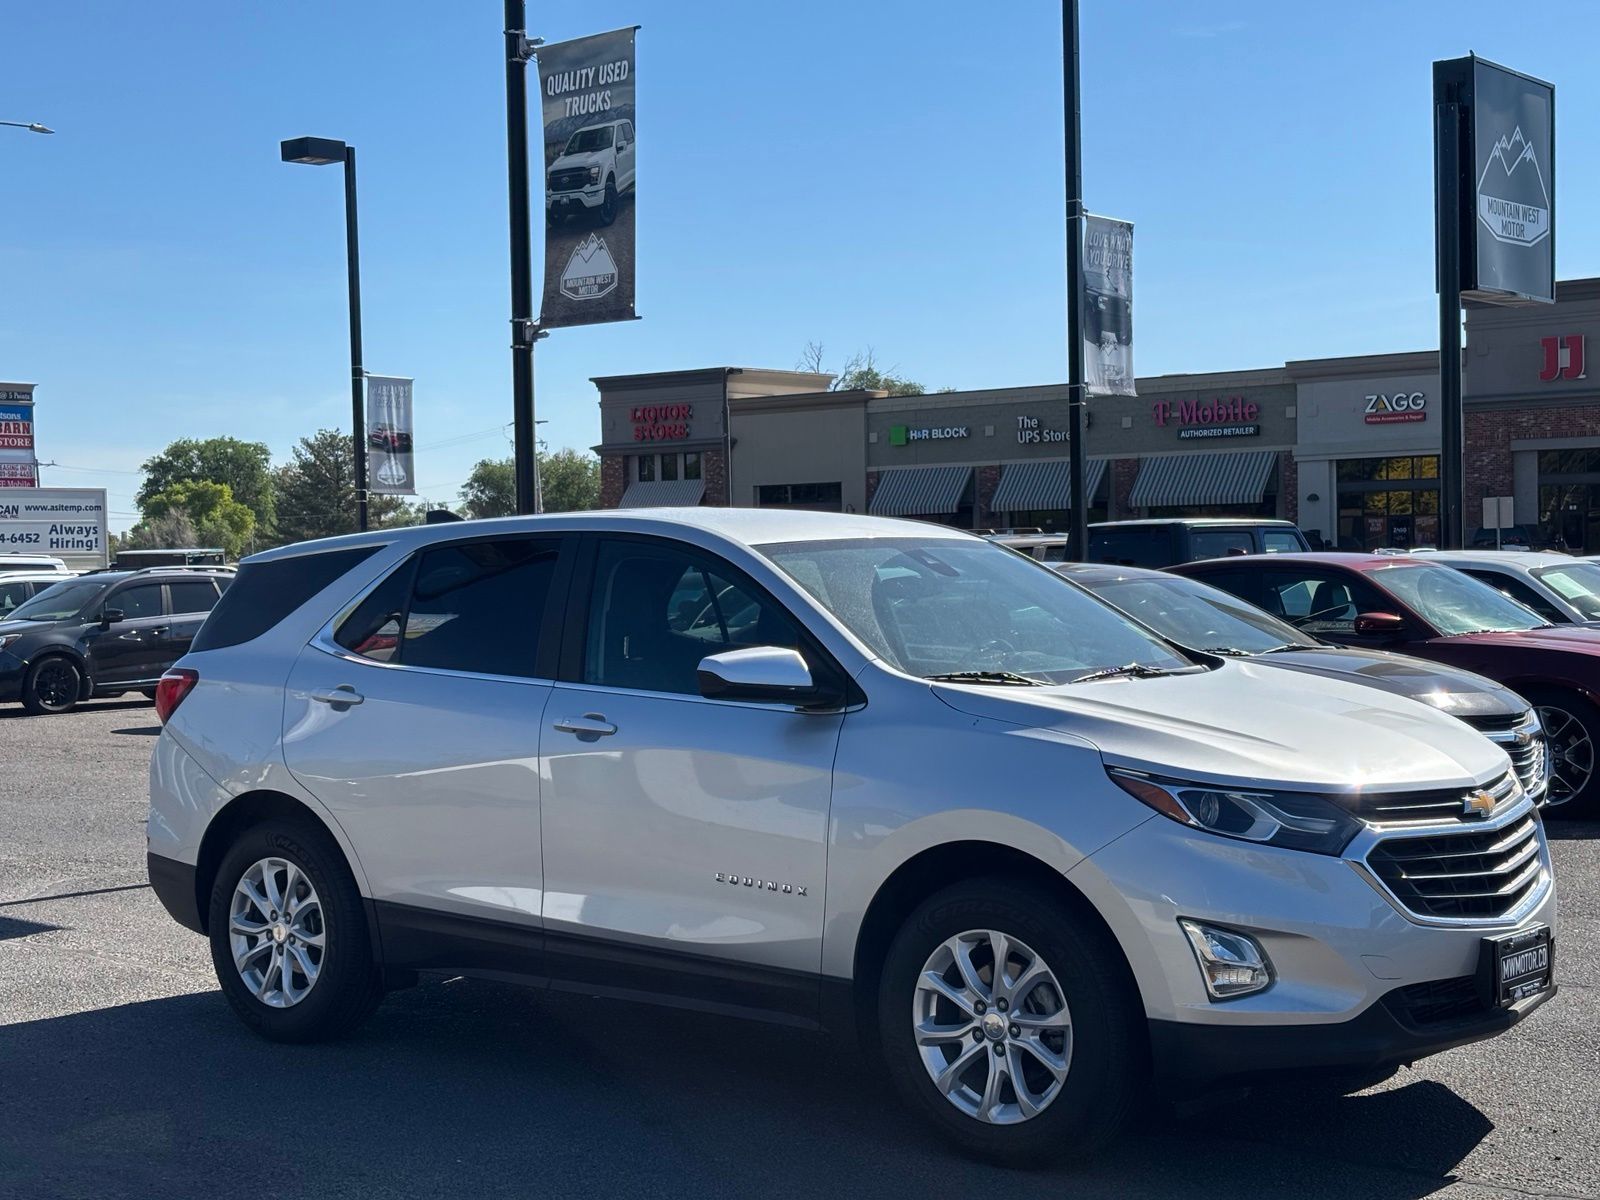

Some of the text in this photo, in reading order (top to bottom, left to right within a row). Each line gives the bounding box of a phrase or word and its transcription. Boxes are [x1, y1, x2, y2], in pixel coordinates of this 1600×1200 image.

[546, 60, 629, 96] QUALITY USED
[565, 90, 611, 117] TRUCKS
[1487, 198, 1541, 225] MOUNTAIN WEST
[1501, 219, 1526, 239] MOTOR
[1089, 232, 1109, 249] LOVE
[1090, 249, 1131, 271] YOU DRIVE
[1151, 397, 1258, 428] T-Mobile
[1364, 392, 1425, 413] ZAGG
[628, 404, 692, 424] LIQUOR
[1017, 415, 1039, 429] The
[632, 423, 690, 441] STORE
[910, 426, 968, 440] H&R BLOCK
[1017, 429, 1070, 444] UPS Store
[1180, 426, 1255, 438] AUTHORIZED RETAILER
[24, 503, 102, 513] www.asitemp.com
[48, 524, 98, 538] Always
[49, 537, 99, 551] Hiring!
[715, 872, 808, 897] EQUINOX
[1502, 947, 1548, 980] MWMOTOR.CO
